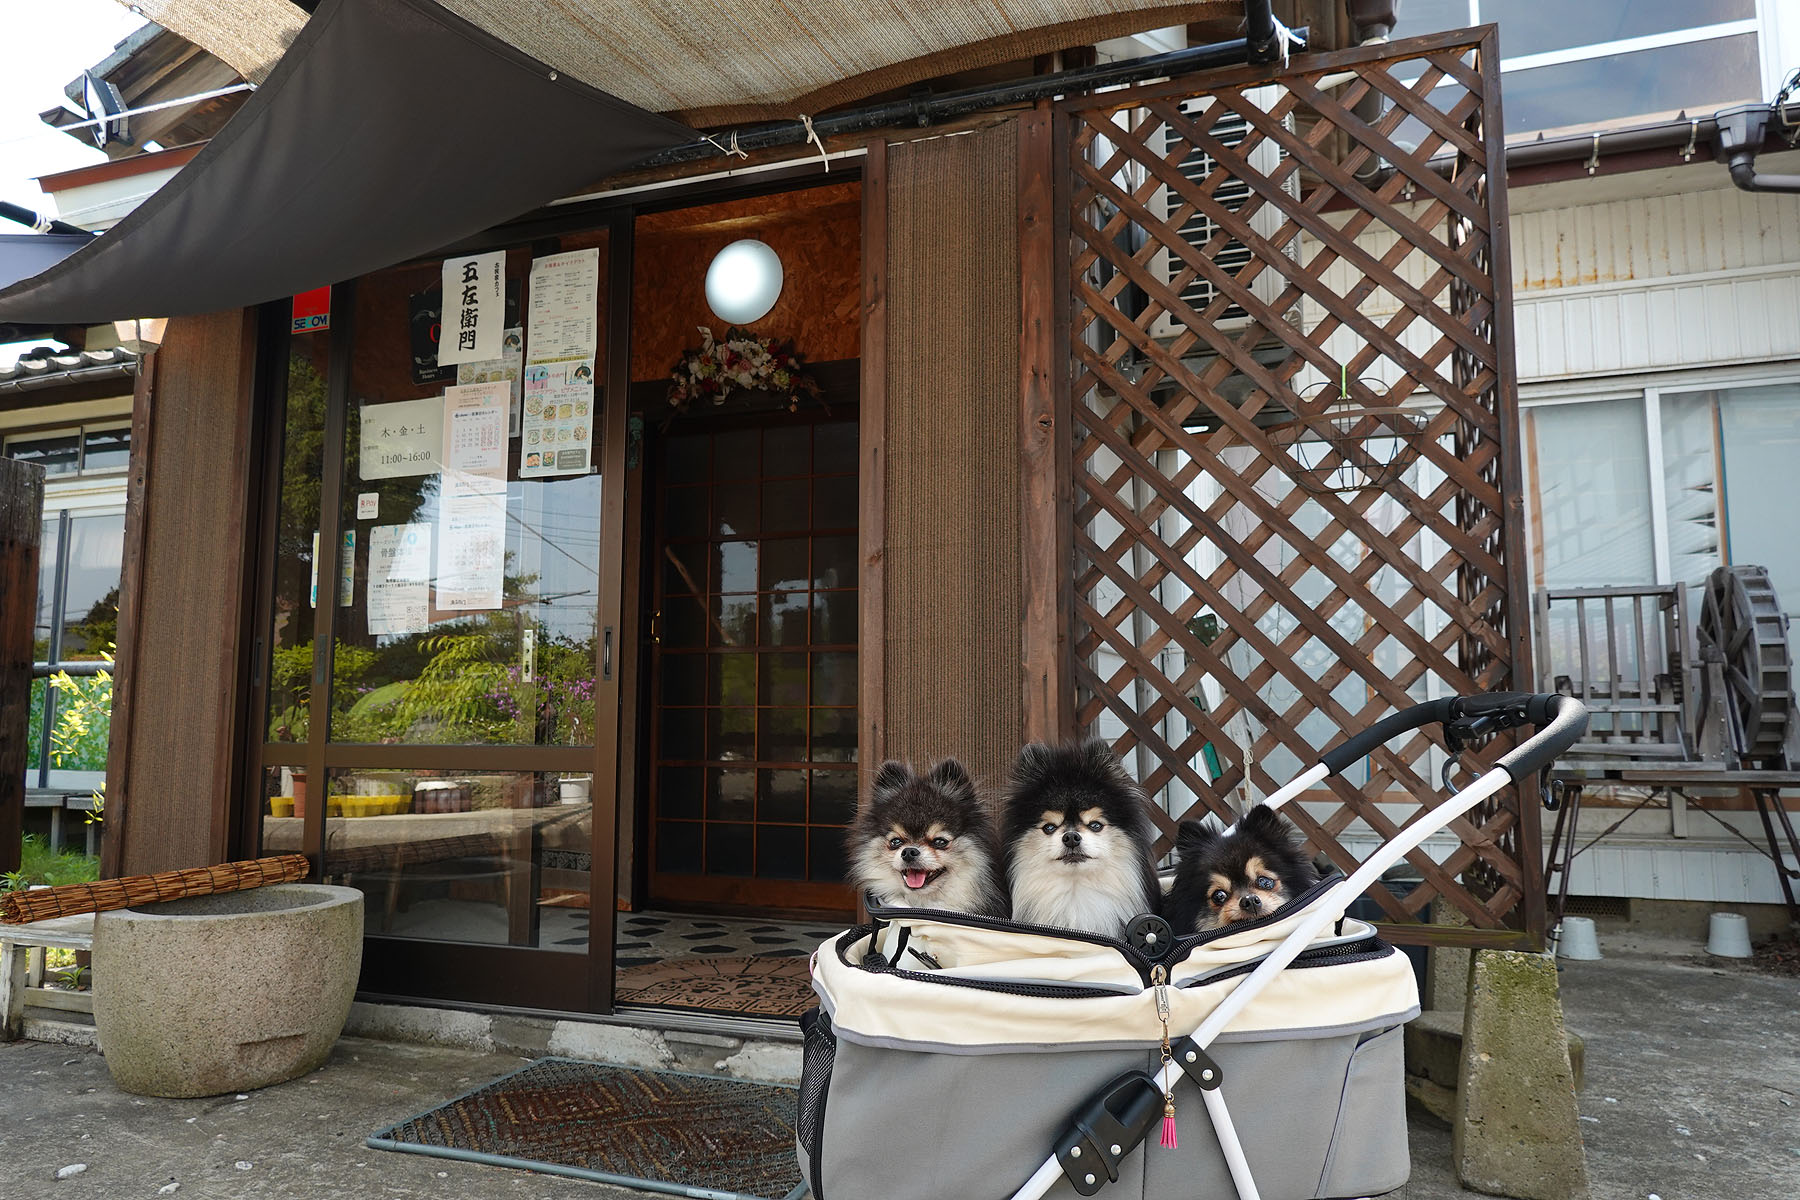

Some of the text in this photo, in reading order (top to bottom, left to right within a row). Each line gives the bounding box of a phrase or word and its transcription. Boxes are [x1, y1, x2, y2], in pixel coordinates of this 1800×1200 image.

[294, 315, 328, 329] SECOM
[458, 261, 479, 352] 五左衛門
